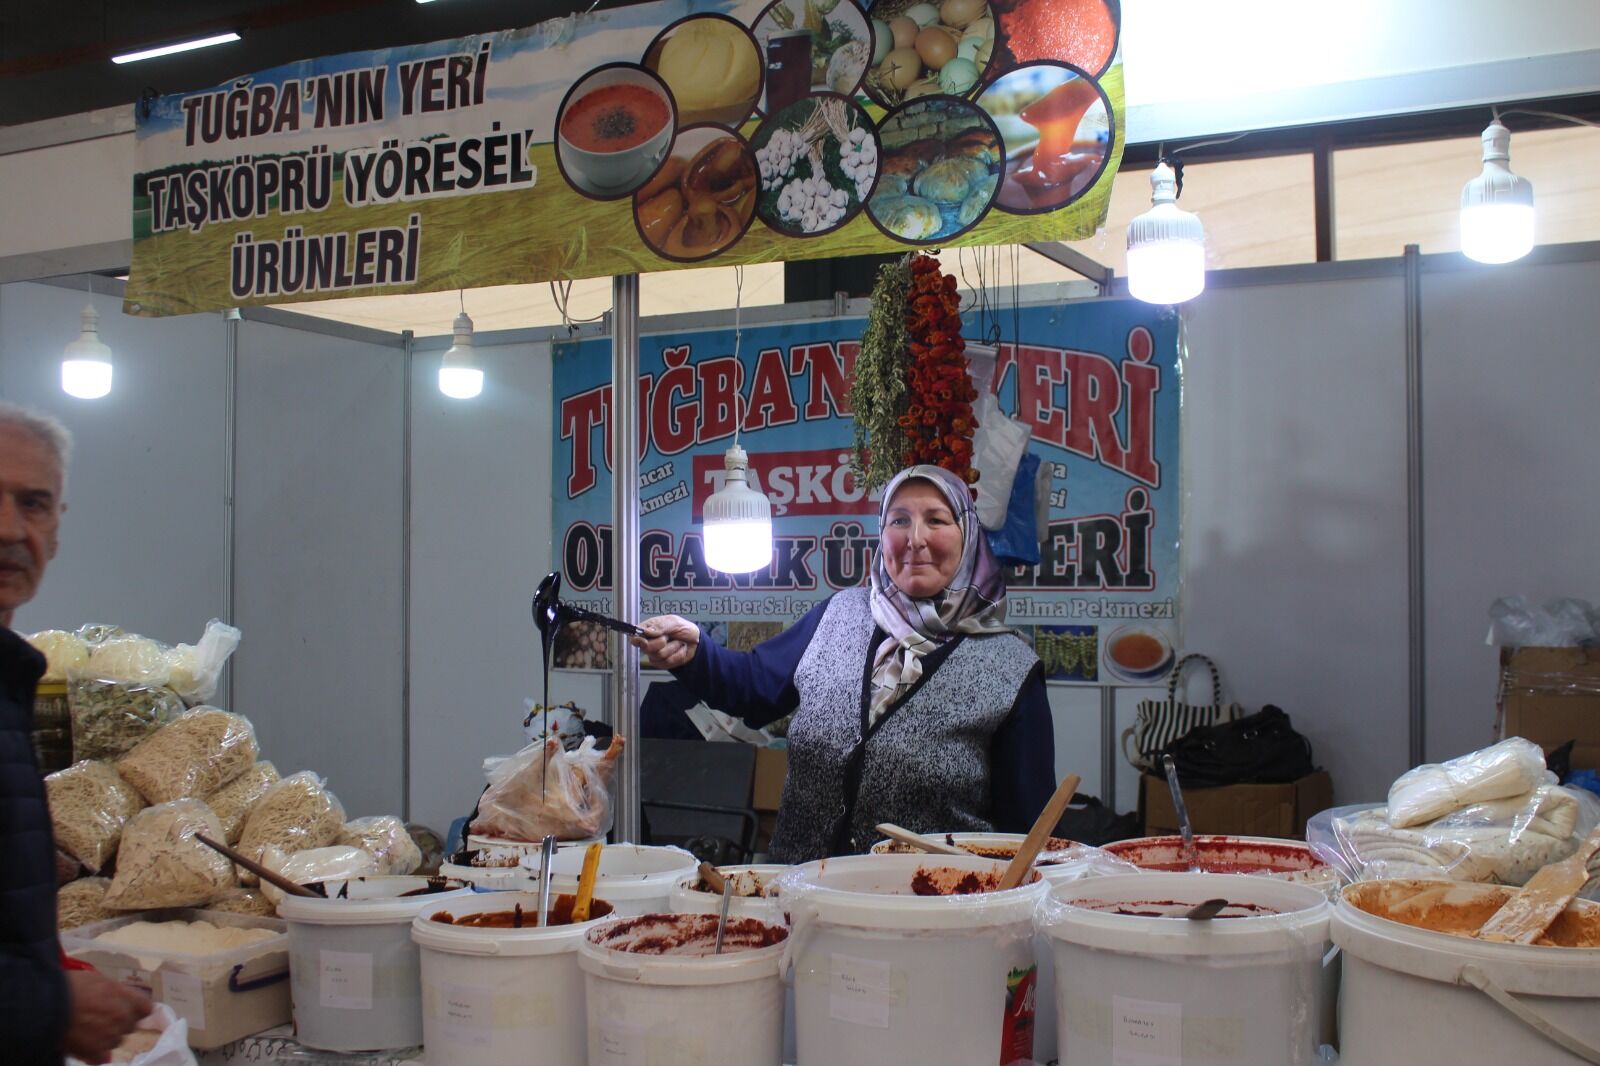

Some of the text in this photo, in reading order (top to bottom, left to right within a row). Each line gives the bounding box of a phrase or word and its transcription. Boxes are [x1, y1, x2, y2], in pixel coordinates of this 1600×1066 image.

[181, 42, 491, 147] TUĞBA'NIN YERİ
[147, 145, 332, 231] TAŞKÖPRÜ
[231, 215, 420, 298] ÜRÜNLERİ
[710, 596, 762, 615] Biber
[1009, 598, 1068, 618] Elma
[1070, 597, 1174, 619] Pekmezi
